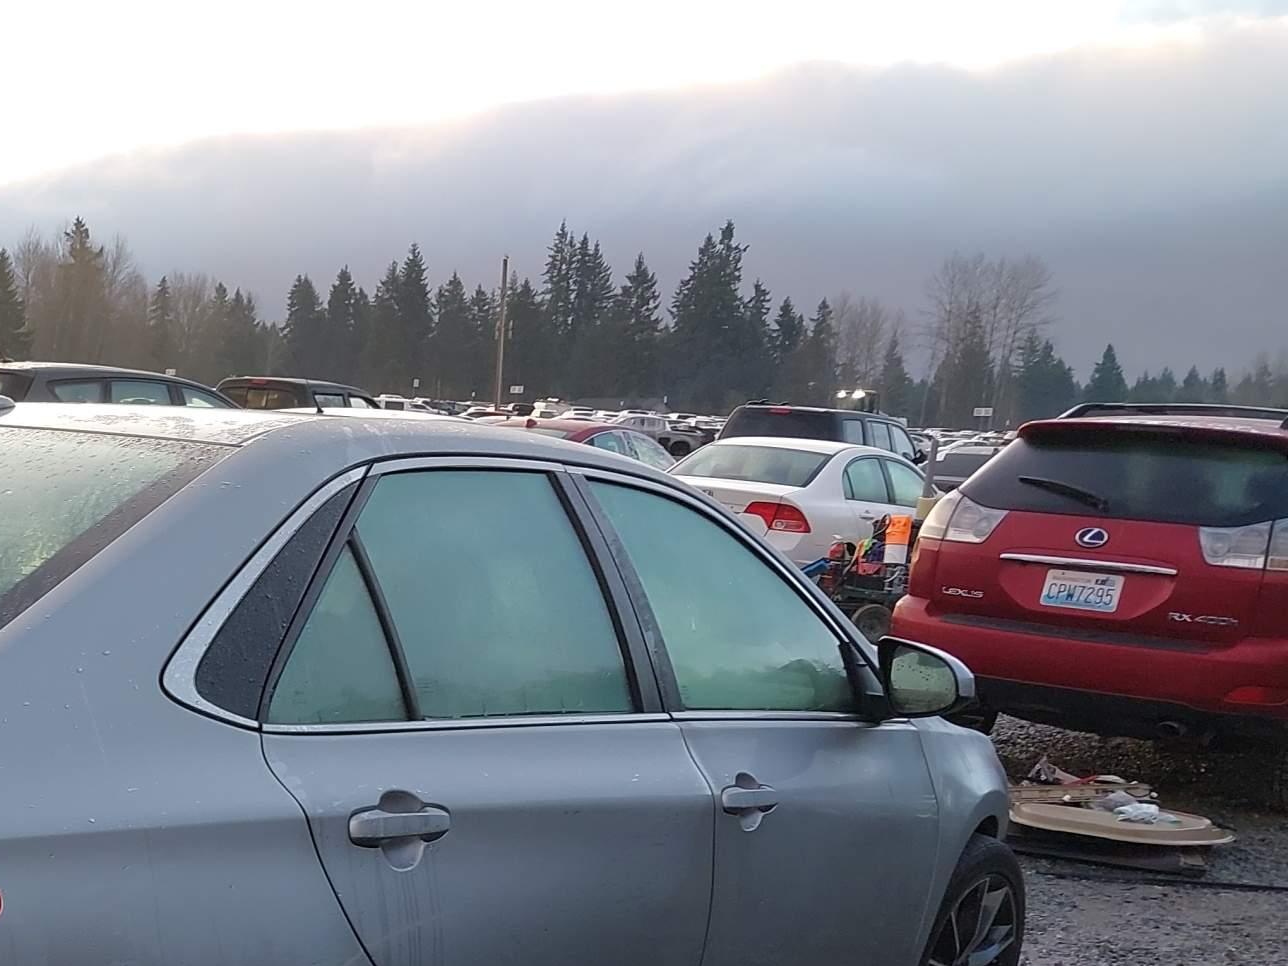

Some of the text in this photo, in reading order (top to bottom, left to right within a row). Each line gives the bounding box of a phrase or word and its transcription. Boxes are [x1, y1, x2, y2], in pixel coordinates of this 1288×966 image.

[941, 586, 985, 598] LEXUS
[1047, 582, 1116, 606] CPW7295
[1168, 611, 1193, 623] RX
